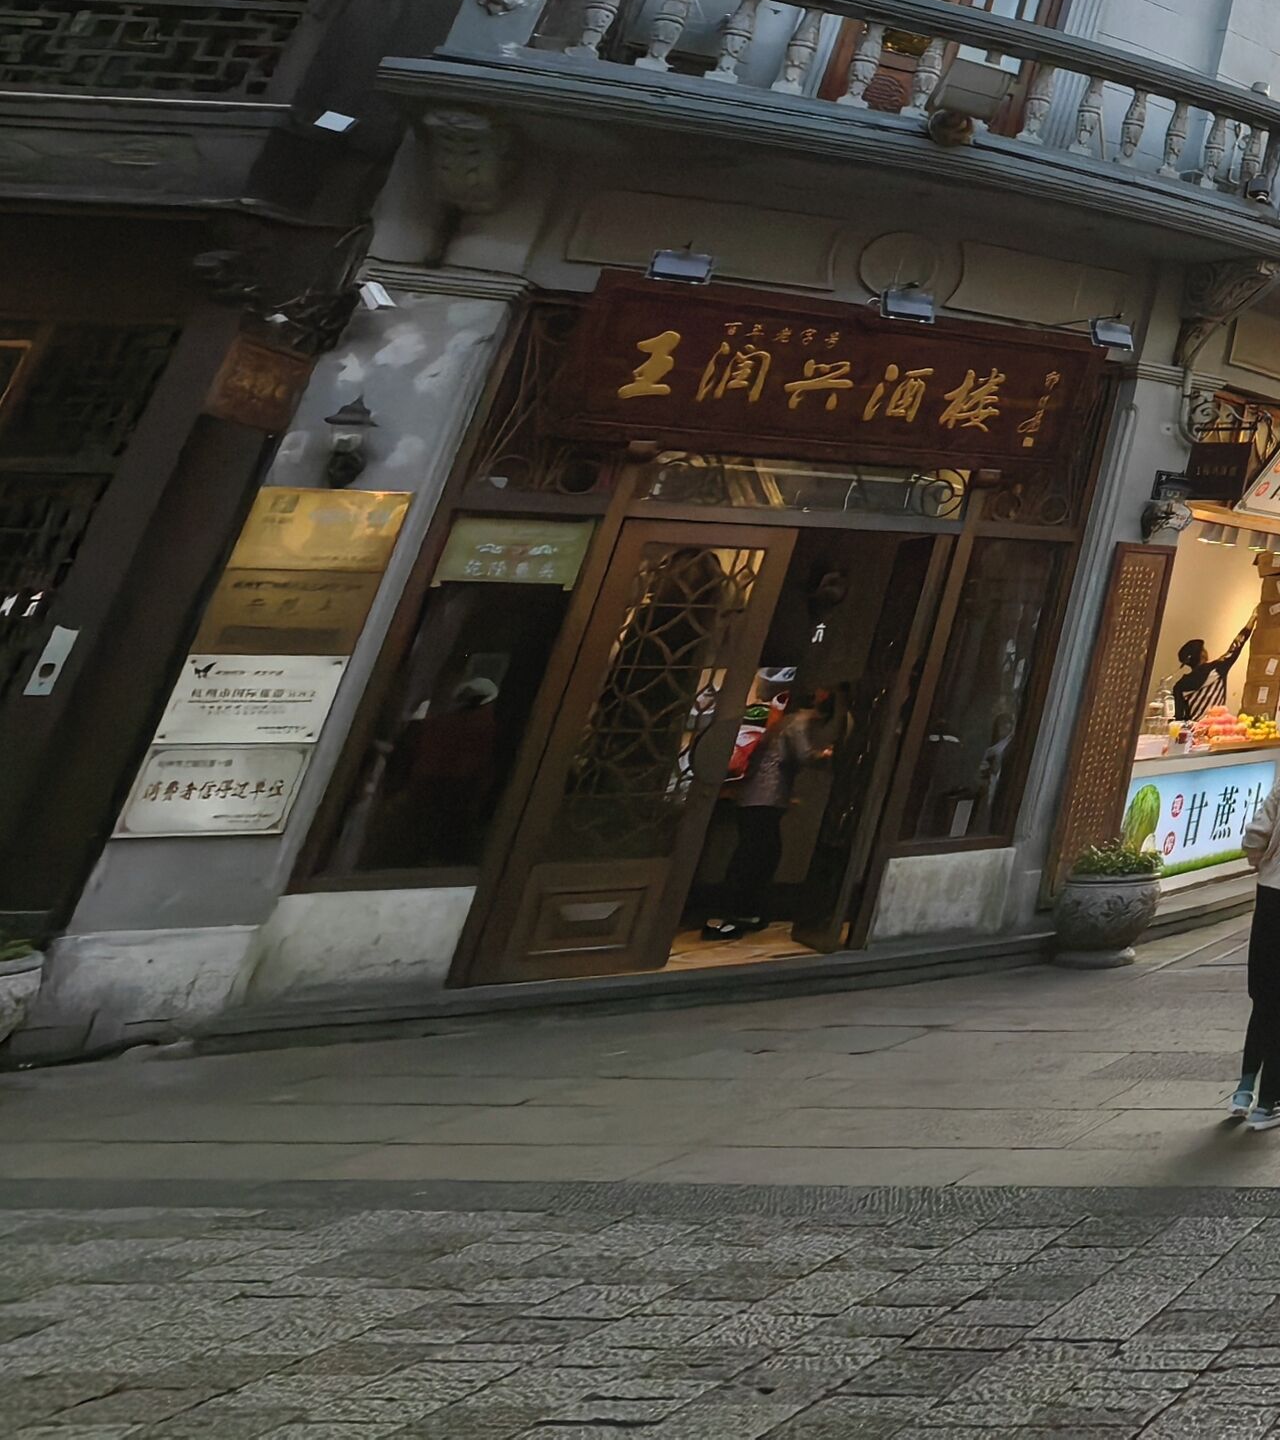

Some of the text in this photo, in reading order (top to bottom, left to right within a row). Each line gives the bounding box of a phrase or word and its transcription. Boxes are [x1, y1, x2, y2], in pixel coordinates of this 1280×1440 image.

[617, 330, 1006, 432] 王润兴酒楼
